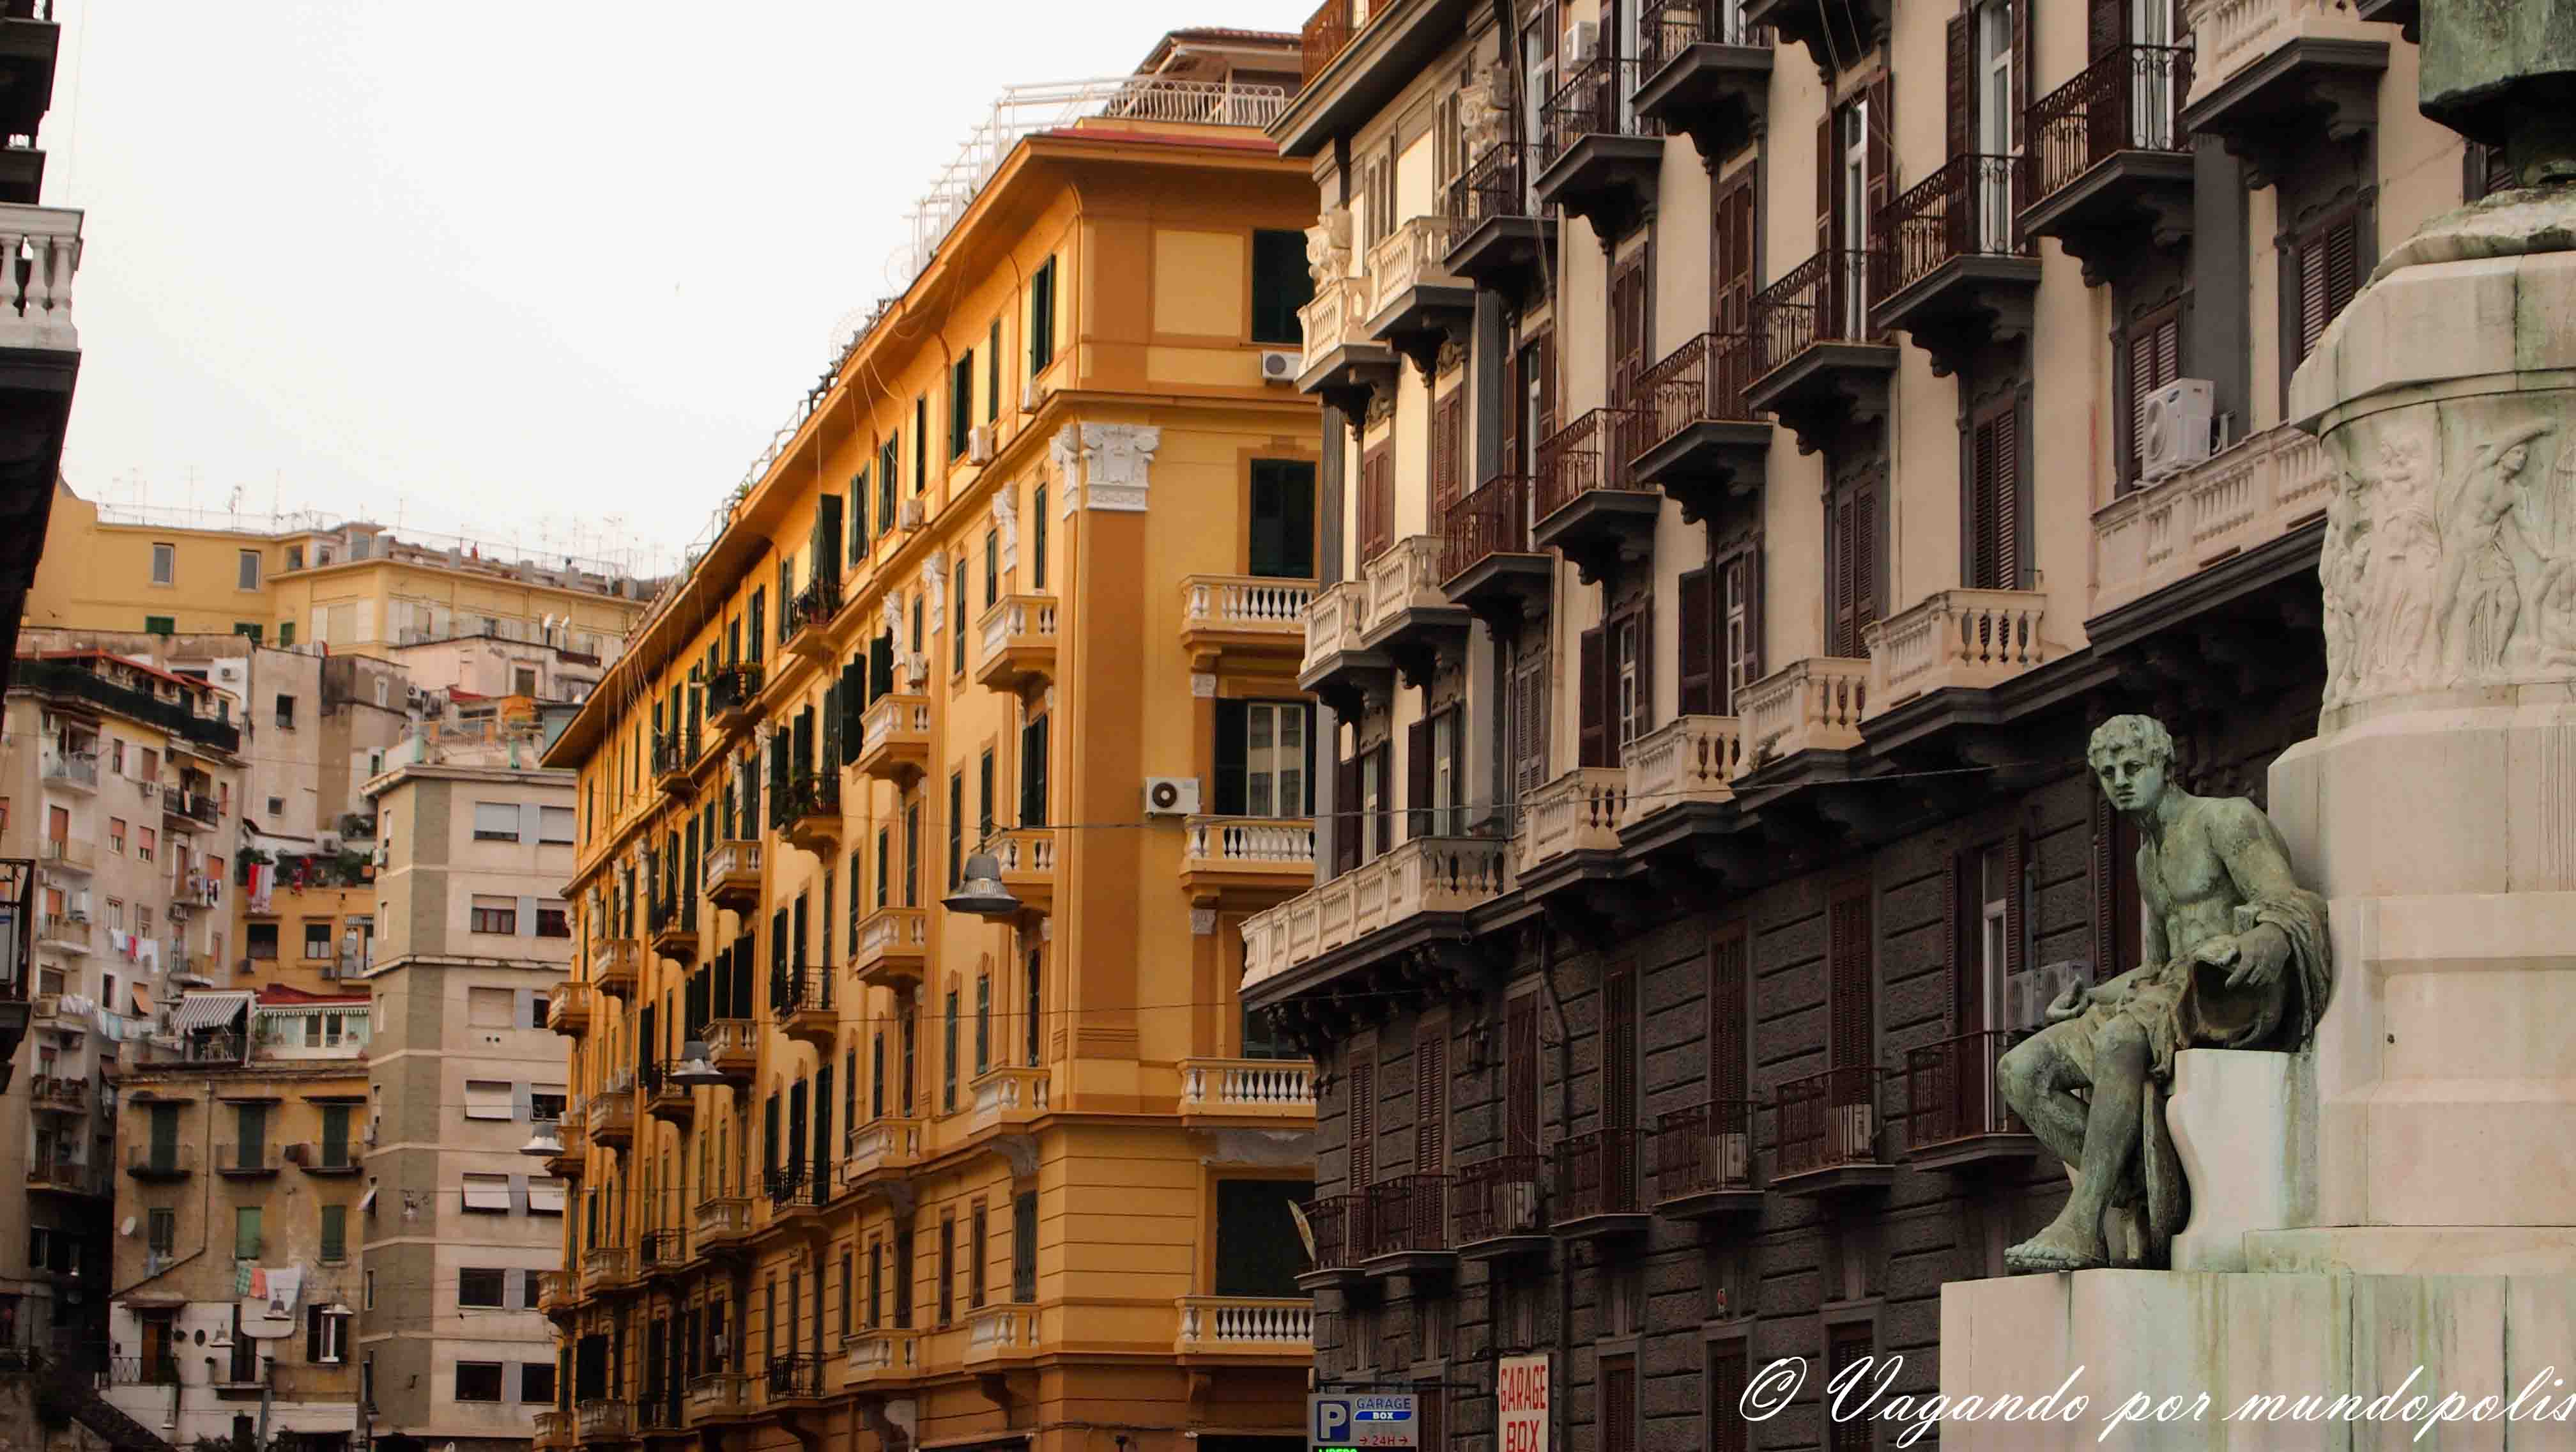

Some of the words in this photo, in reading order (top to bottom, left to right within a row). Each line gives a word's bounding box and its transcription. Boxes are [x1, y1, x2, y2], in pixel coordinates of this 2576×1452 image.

[1501, 1365, 1545, 1411] GARAGE
[1356, 1397, 1411, 1410] GARAGE
[1321, 1403, 1347, 1439] P
[1372, 1412, 1394, 1420] BOX
[1372, 1435, 1395, 1445] 24H
[1506, 1419, 1540, 1452] BOX
